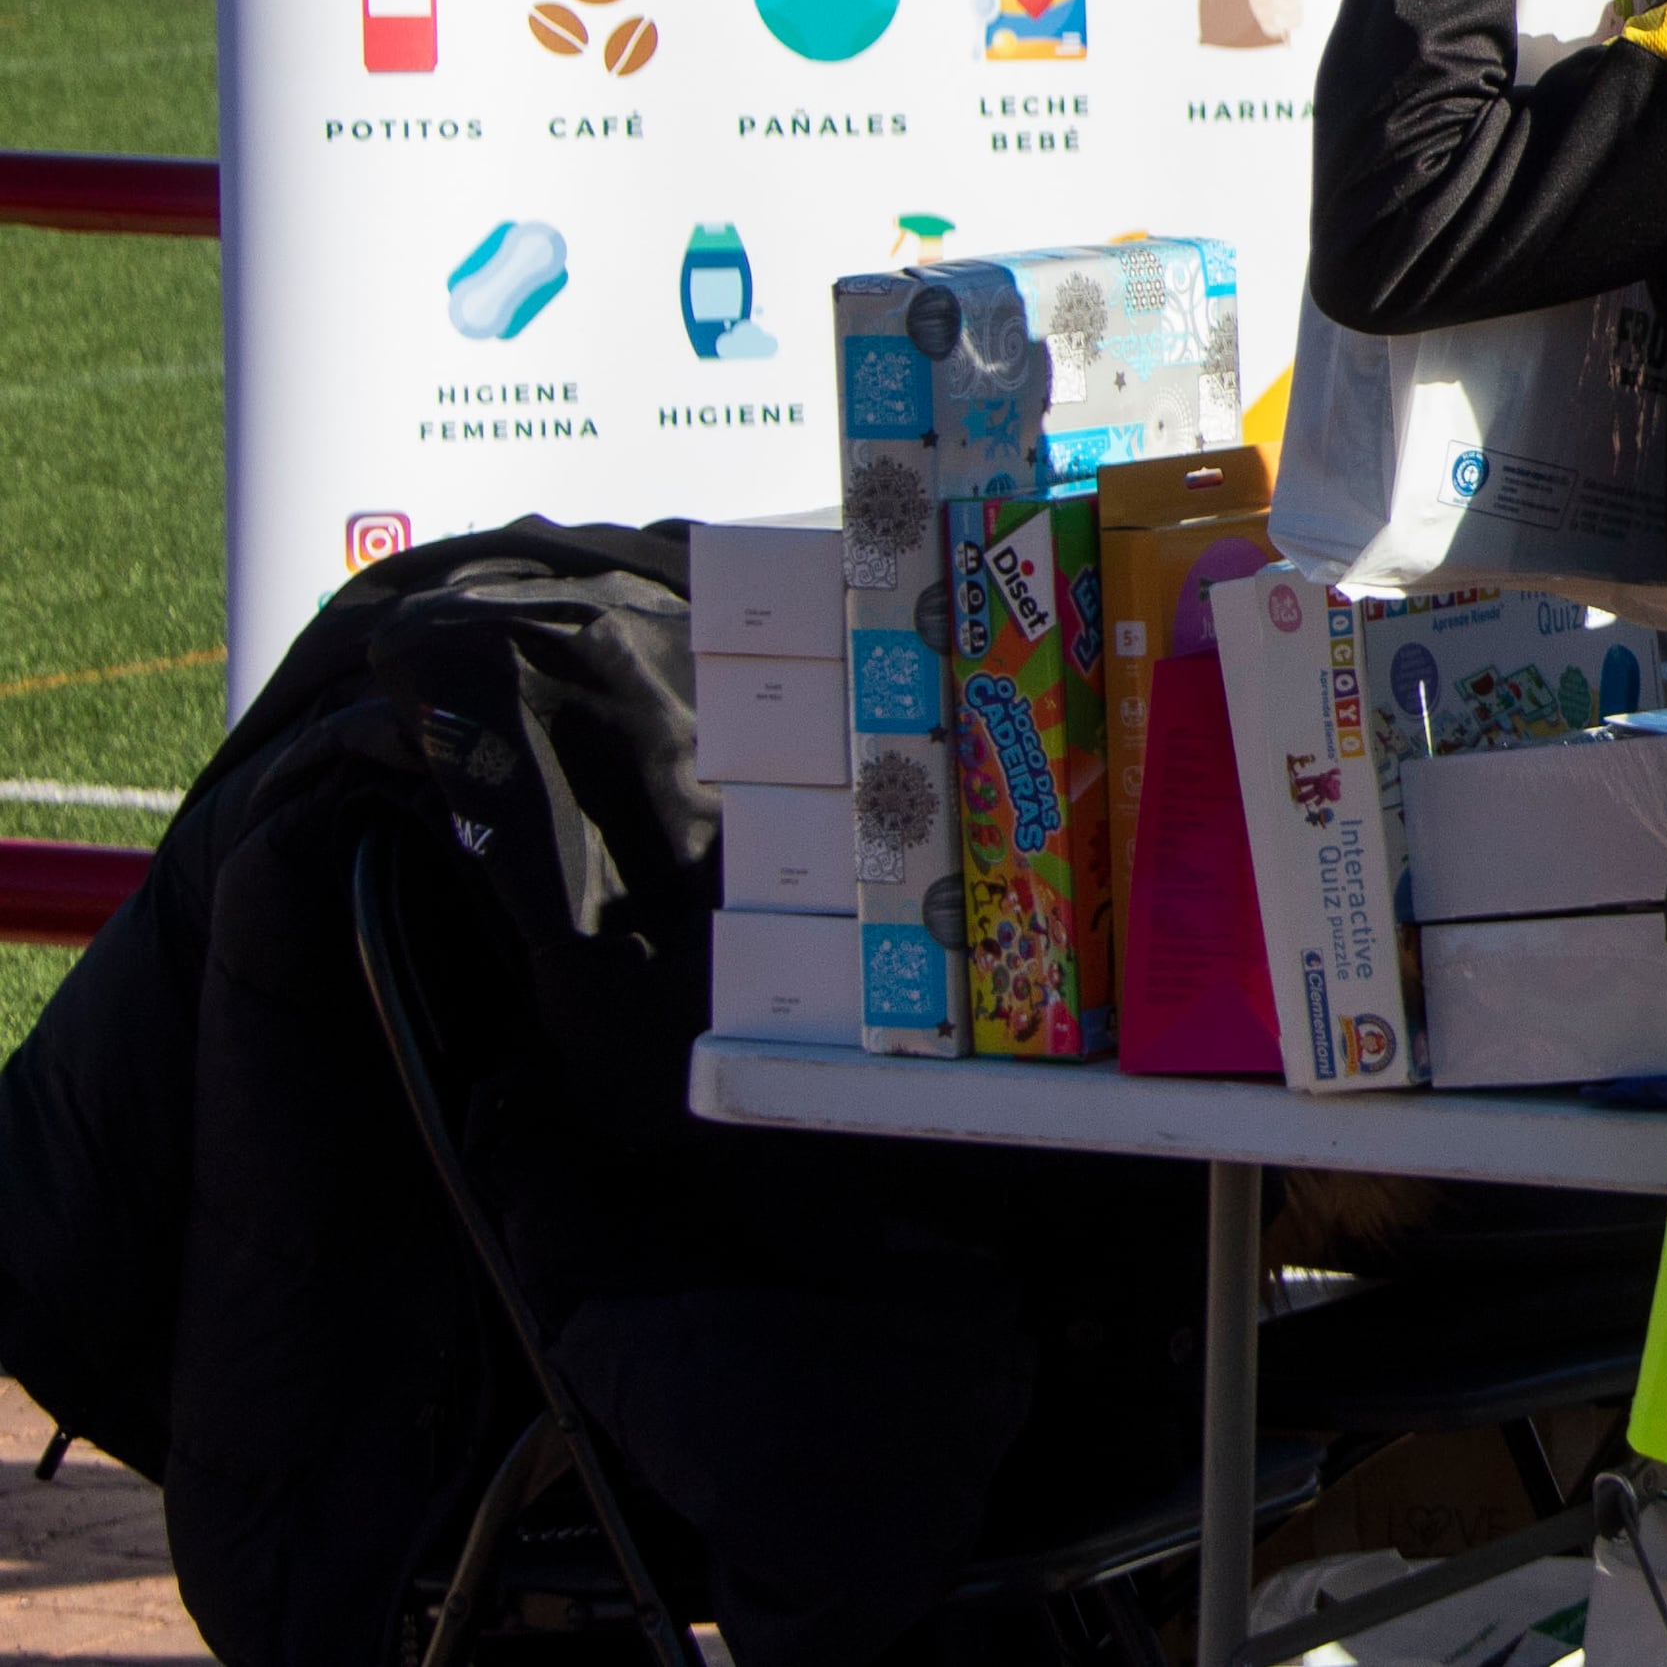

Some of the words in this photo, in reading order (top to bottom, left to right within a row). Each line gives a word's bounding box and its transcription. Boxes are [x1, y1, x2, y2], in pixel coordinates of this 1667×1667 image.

[978, 94, 1091, 119] LECHE
[324, 118, 485, 144] POTITOS
[547, 110, 645, 140] CAFÉ
[737, 108, 909, 139] PAÑALES
[990, 124, 1081, 154] BEBÉ
[436, 382, 581, 406] HIGIENE
[418, 417, 601, 442] FEMENINA
[657, 402, 806, 429] HIGIENE
[991, 545, 1050, 634] Diset
[966, 675, 1047, 853] CADEIRAS
[1006, 698, 1048, 771] JOGO
[1033, 771, 1062, 831] DAS
[1318, 845, 1342, 910] Quiz
[1340, 819, 1377, 980] Interactive
[1327, 916, 1350, 981] puzzle
[1306, 971, 1335, 1079] Clementoni
